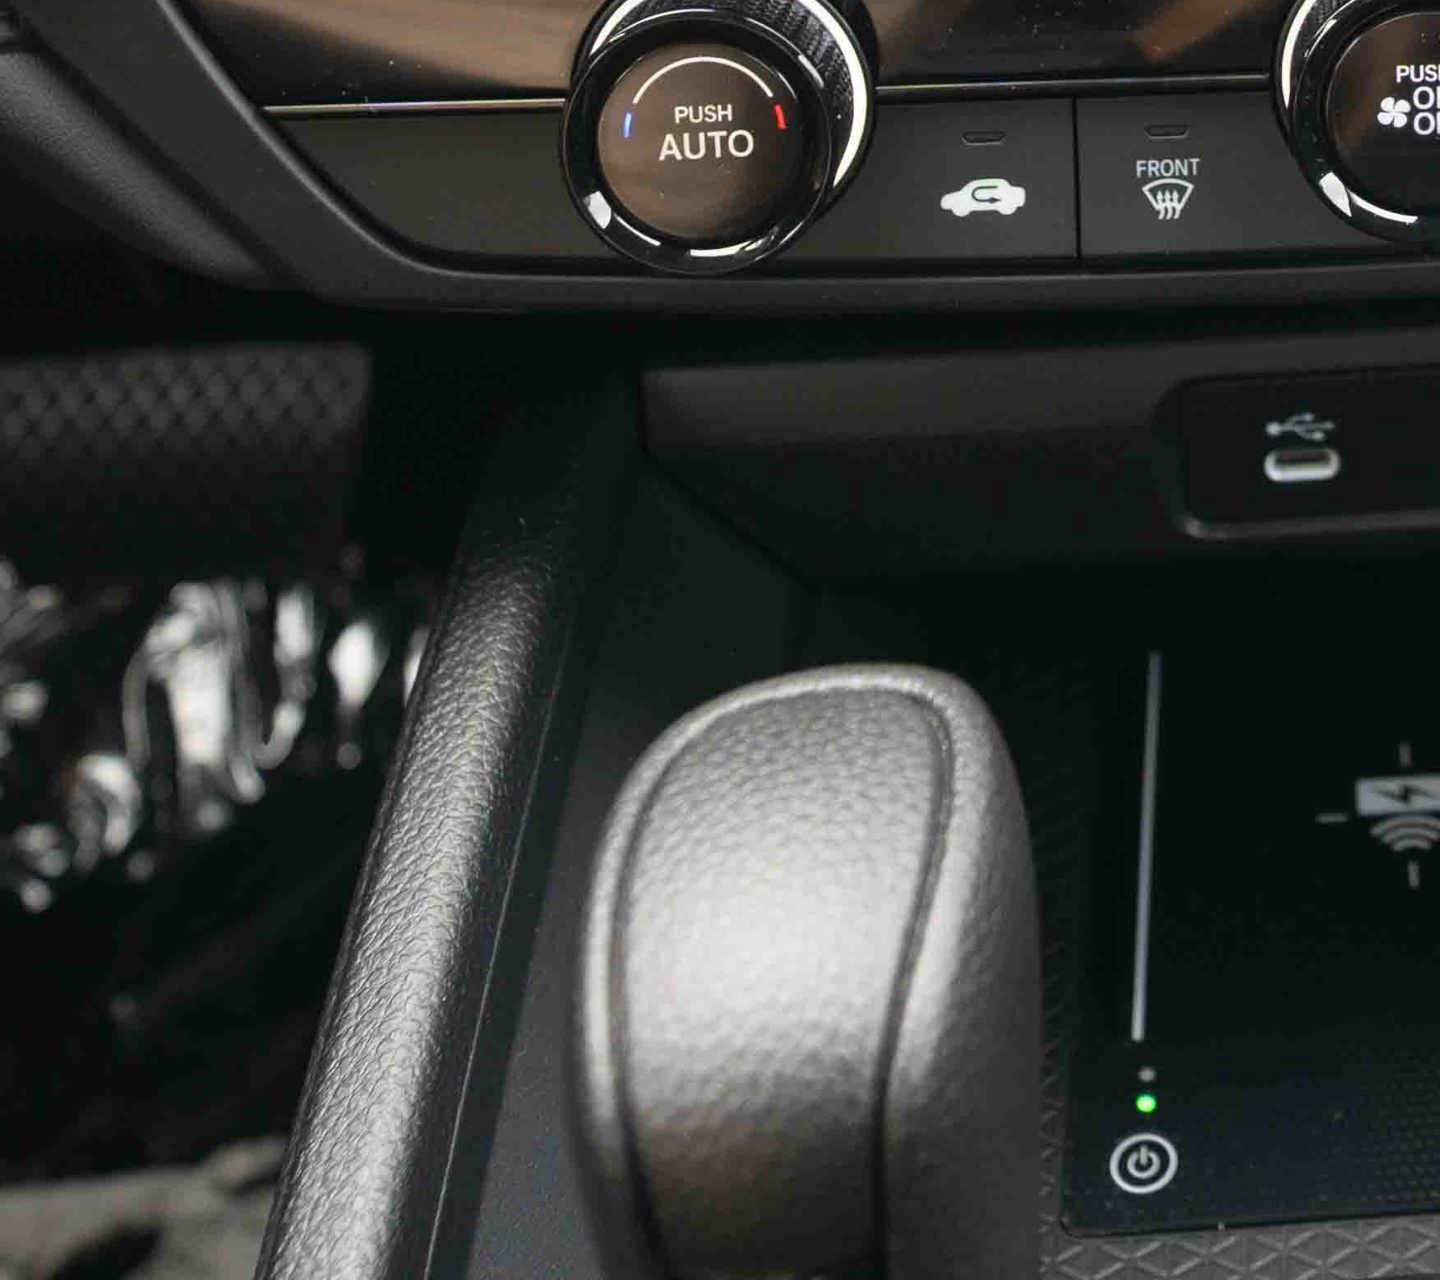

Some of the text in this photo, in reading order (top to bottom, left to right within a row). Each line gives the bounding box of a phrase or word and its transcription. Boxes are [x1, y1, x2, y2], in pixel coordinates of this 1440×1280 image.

[674, 103, 733, 124] PUSH
[658, 129, 754, 161] AUTO
[1136, 158, 1201, 178] FRONT
